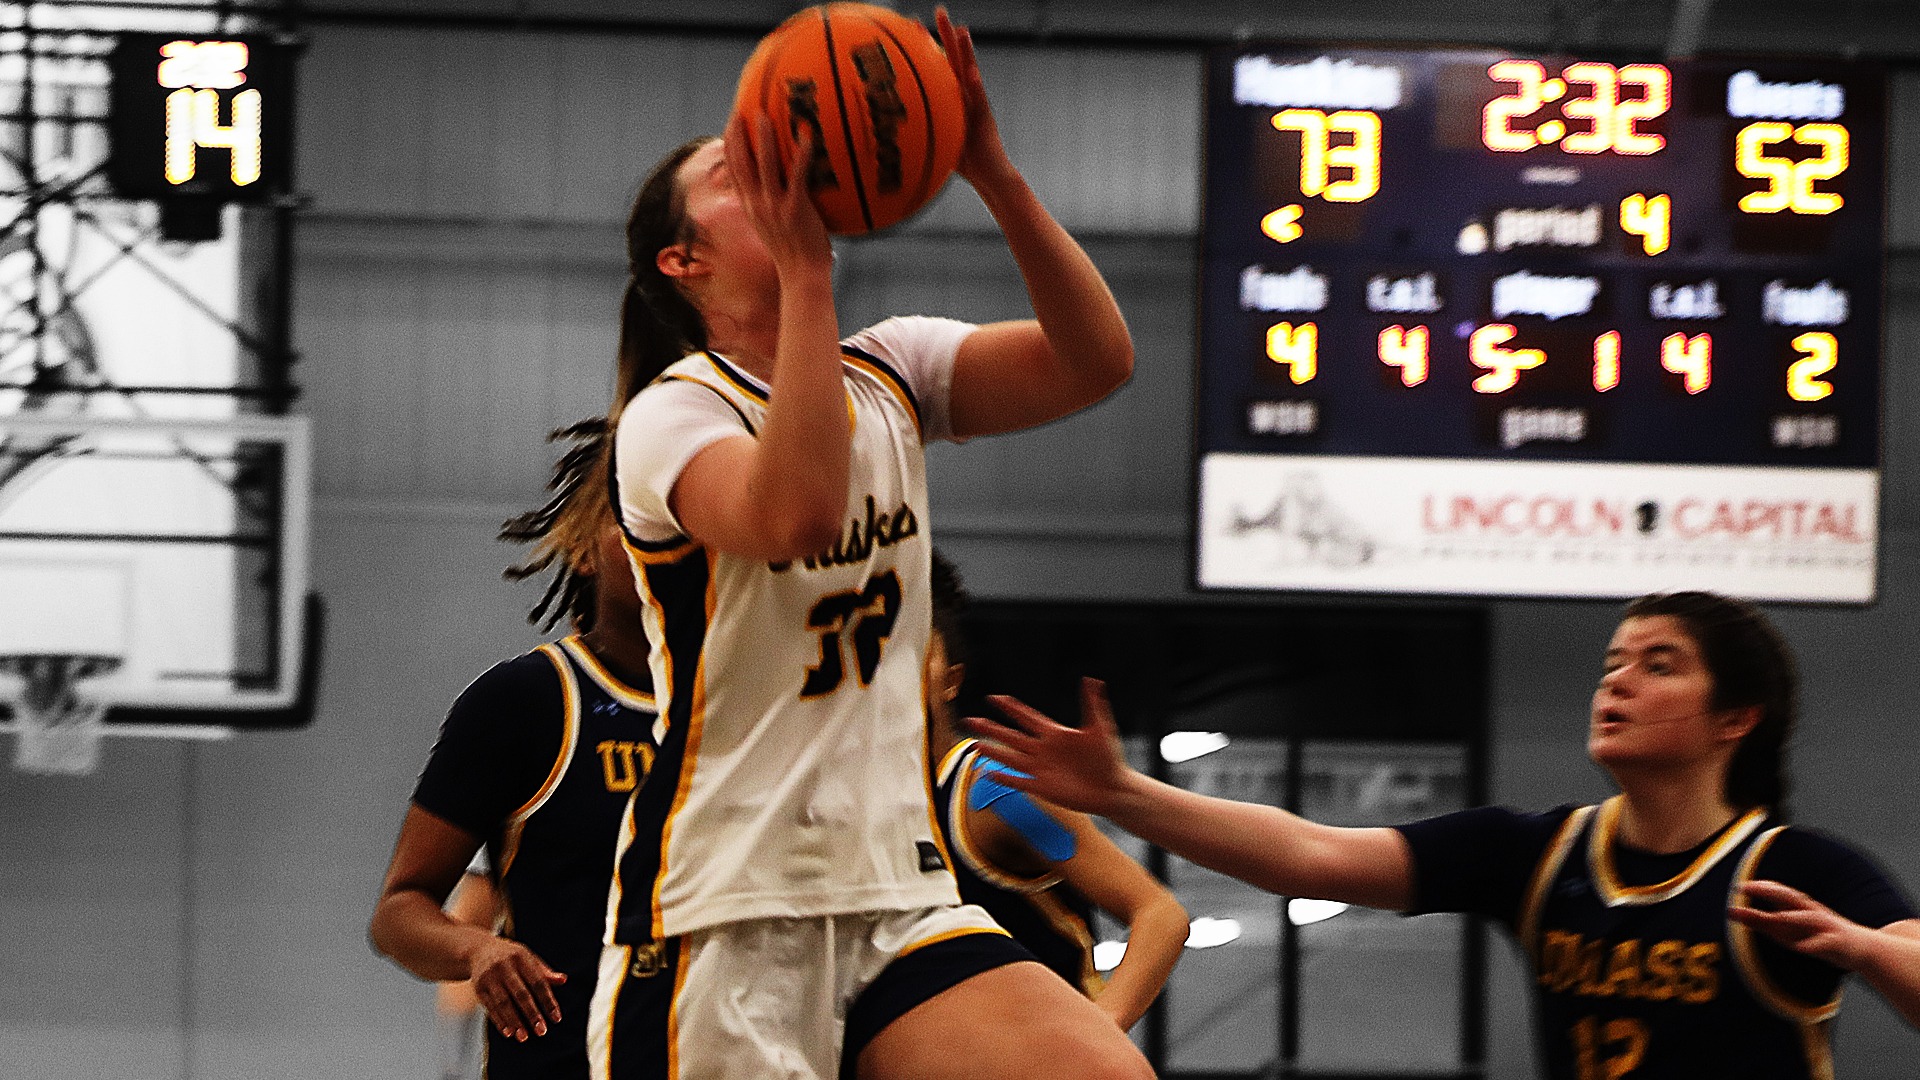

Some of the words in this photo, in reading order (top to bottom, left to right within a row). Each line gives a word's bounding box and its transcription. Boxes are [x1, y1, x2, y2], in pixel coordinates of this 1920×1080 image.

[165, 87, 262, 187] 14
[1482, 59, 1672, 155] 2:32
[1270, 108, 1382, 203] 73
[1736, 121, 1850, 215] 52
[1620, 193, 1672, 257] 4
[1266, 321, 1318, 385] 4
[1378, 324, 1430, 388] 4
[1661, 332, 1712, 395] 4
[1786, 331, 1839, 402] 2
[1420, 494, 1624, 540] LINCOLN
[1669, 497, 1863, 545] CAPITAL
